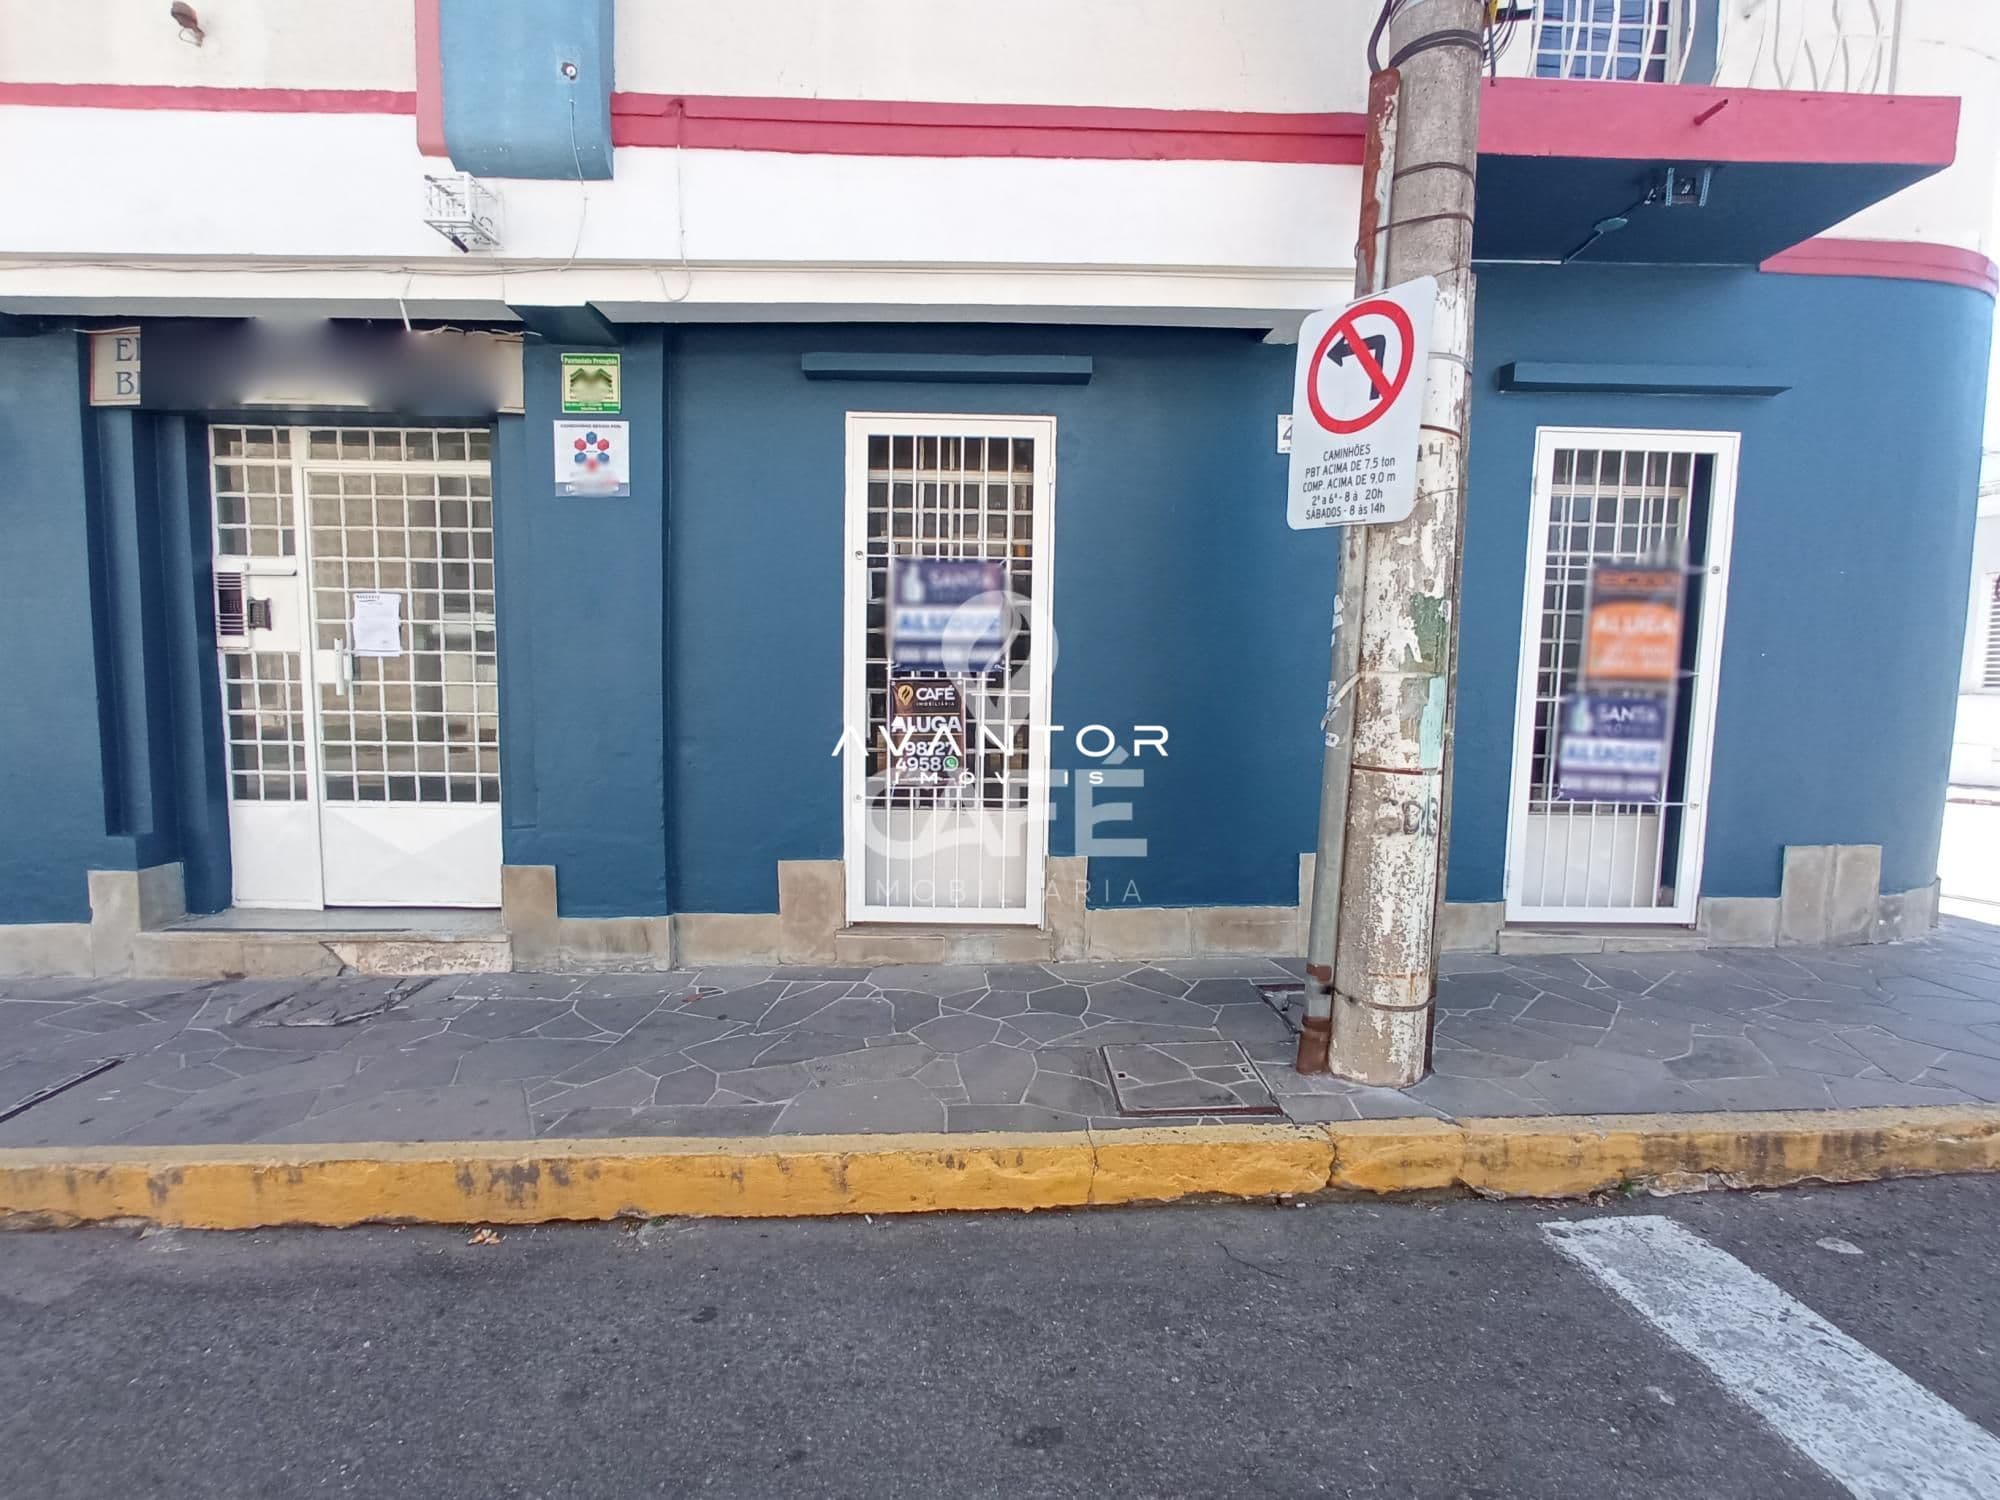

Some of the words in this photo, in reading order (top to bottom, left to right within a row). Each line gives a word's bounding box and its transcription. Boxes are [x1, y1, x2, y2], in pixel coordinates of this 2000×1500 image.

[1322, 443, 1371, 462] CAMINHÕES
[1305, 466, 1320, 478] PBT
[1322, 462, 1348, 476] ACIMA
[1350, 460, 1362, 472] DE
[1381, 456, 1395, 467] ton
[1302, 479, 1325, 493] COMP.
[1327, 476, 1353, 489] ACIMA
[1355, 473, 1367, 486] DE
[1386, 472, 1396, 482] m
[1321, 496, 1327, 505] a
[1344, 491, 1350, 502] 8
[1365, 488, 1383, 500] 20h
[1305, 506, 1341, 520] SÁBADOS
[1349, 504, 1355, 516] 8
[1358, 503, 1368, 515] às
[1370, 502, 1385, 514] 14h
[916, 685, 956, 700] CAFÉ
[891, 716, 962, 733] ALUGA
[895, 757, 941, 772] 4958
